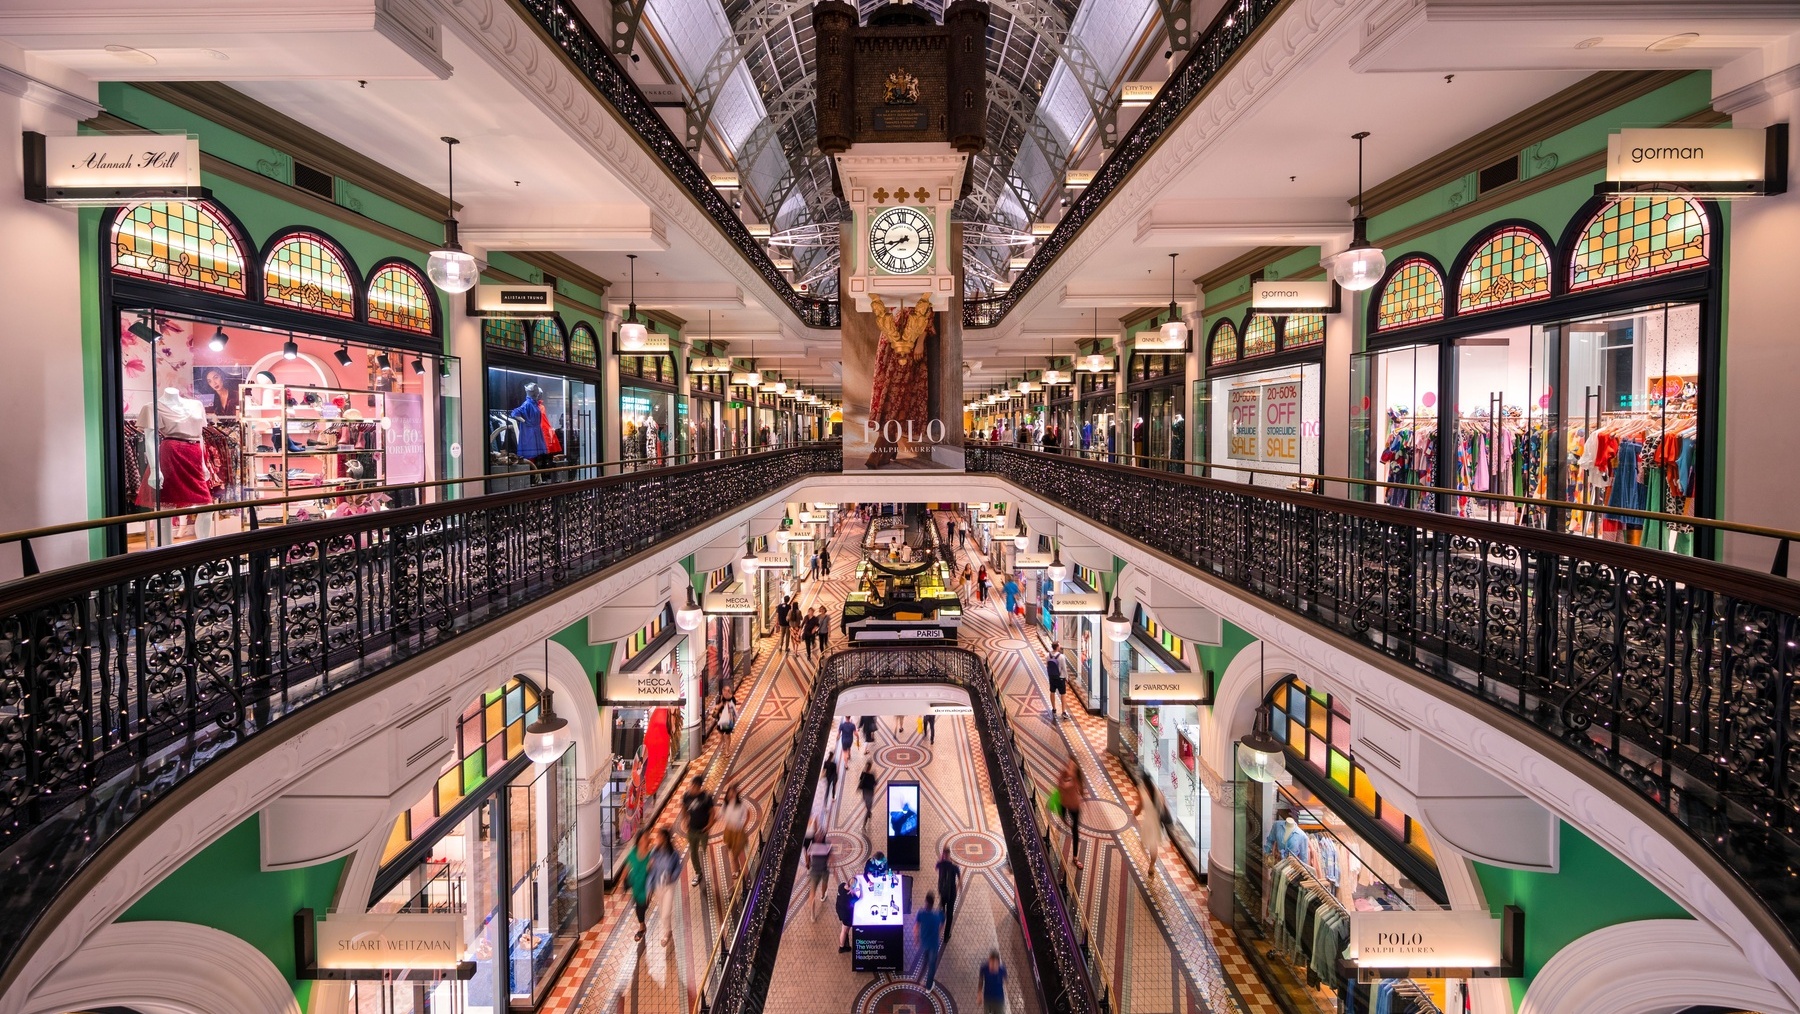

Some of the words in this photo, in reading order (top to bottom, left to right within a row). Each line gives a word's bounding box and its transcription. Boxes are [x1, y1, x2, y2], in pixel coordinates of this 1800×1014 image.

[72, 152, 133, 169] Alannah
[138, 152, 180, 168] Hill
[1632, 148, 1703, 163] gorman
[1262, 290, 1298, 299] gorman
[1267, 386, 1297, 400] 20-50%
[1232, 405, 1256, 424] OFF
[1267, 402, 1296, 424] OFF
[864, 418, 946, 444] POLO
[1267, 427, 1296, 435] STOREWIDE
[1232, 437, 1256, 456] SALE
[1267, 438, 1296, 458] SALE
[338, 940, 381, 950] STUART
[387, 940, 451, 950] WEITZMAN
[1378, 933, 1422, 945] POLO
